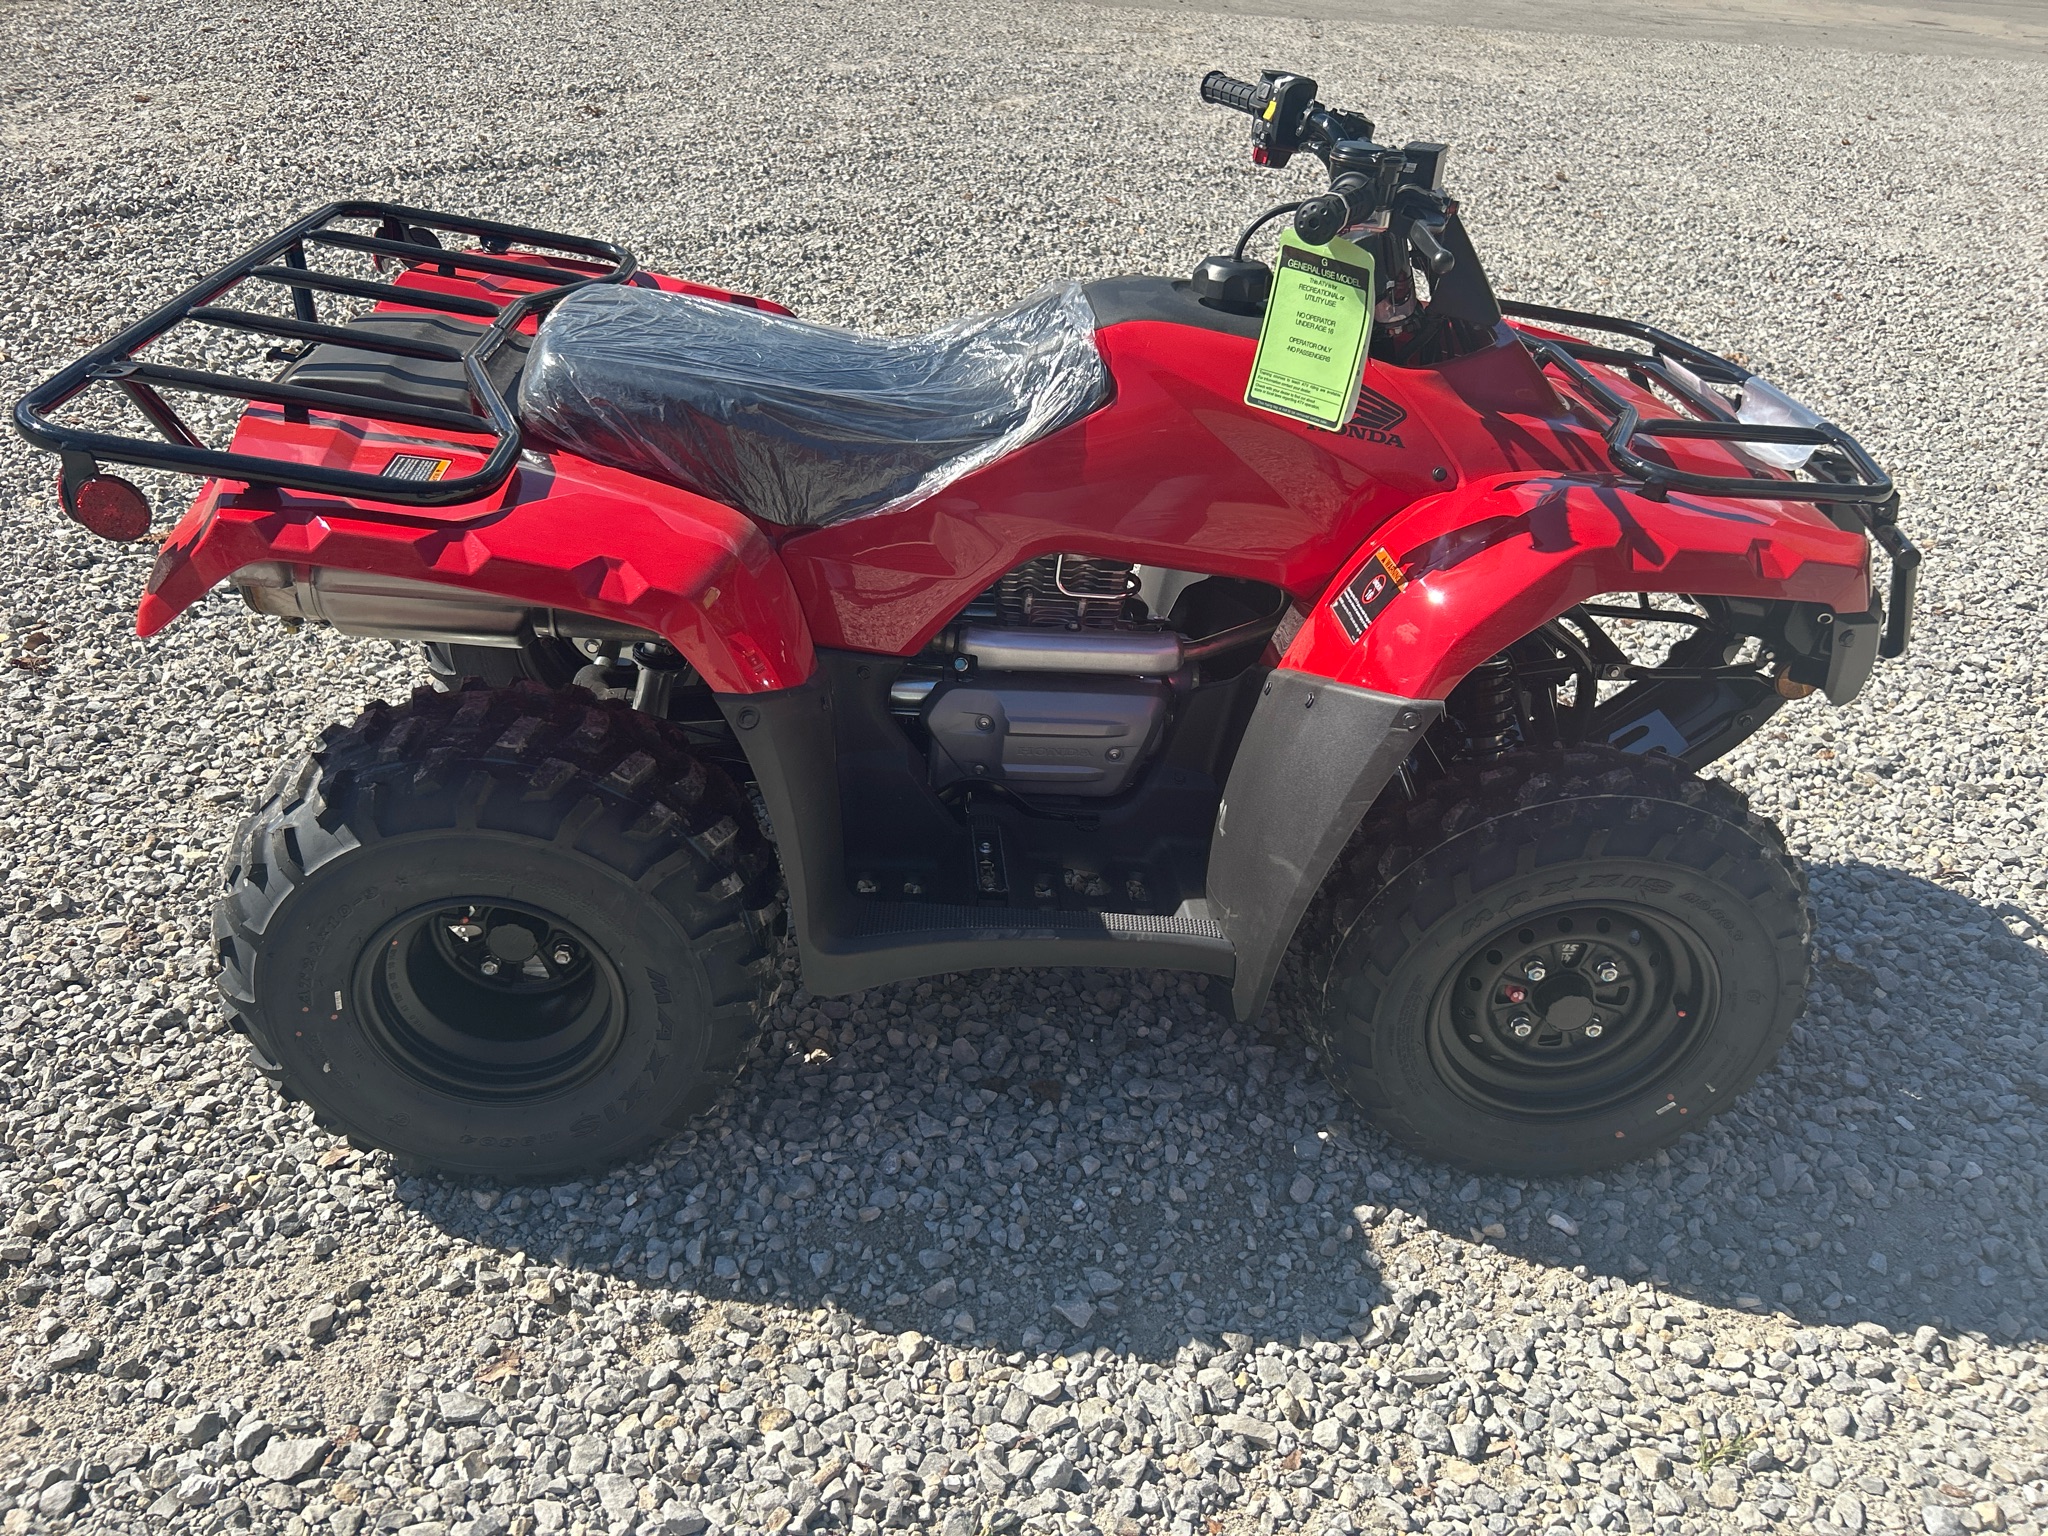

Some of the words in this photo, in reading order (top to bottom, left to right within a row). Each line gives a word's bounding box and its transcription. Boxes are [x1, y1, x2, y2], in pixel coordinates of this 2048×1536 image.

[1321, 257, 1328, 267] G
[1287, 258, 1320, 275] GENERAL
[1321, 268, 1336, 279] USE
[1336, 272, 1361, 287] MODEL
[1309, 277, 1319, 285] This
[1318, 279, 1328, 288] ATV
[1298, 283, 1340, 300] RECREATIONAL
[1304, 293, 1325, 306] UTILITY
[1324, 298, 1337, 308] USE
[1295, 318, 1315, 330] UNDER
[1314, 323, 1327, 333] AGE
[1327, 327, 1335, 335] 16
[1296, 310, 1306, 319] NO
[1305, 312, 1337, 327] OPERATOR
[1288, 336, 1318, 350] OPERATOR
[1317, 343, 1333, 354] ONLY
[1296, 347, 1331, 363] PASSENGERS
[1307, 422, 1405, 448] ONDA
[1017, 746, 1094, 758] HONDA
[1461, 874, 1676, 938] MAXXIS
[569, 966, 675, 1138] MAXXIS
